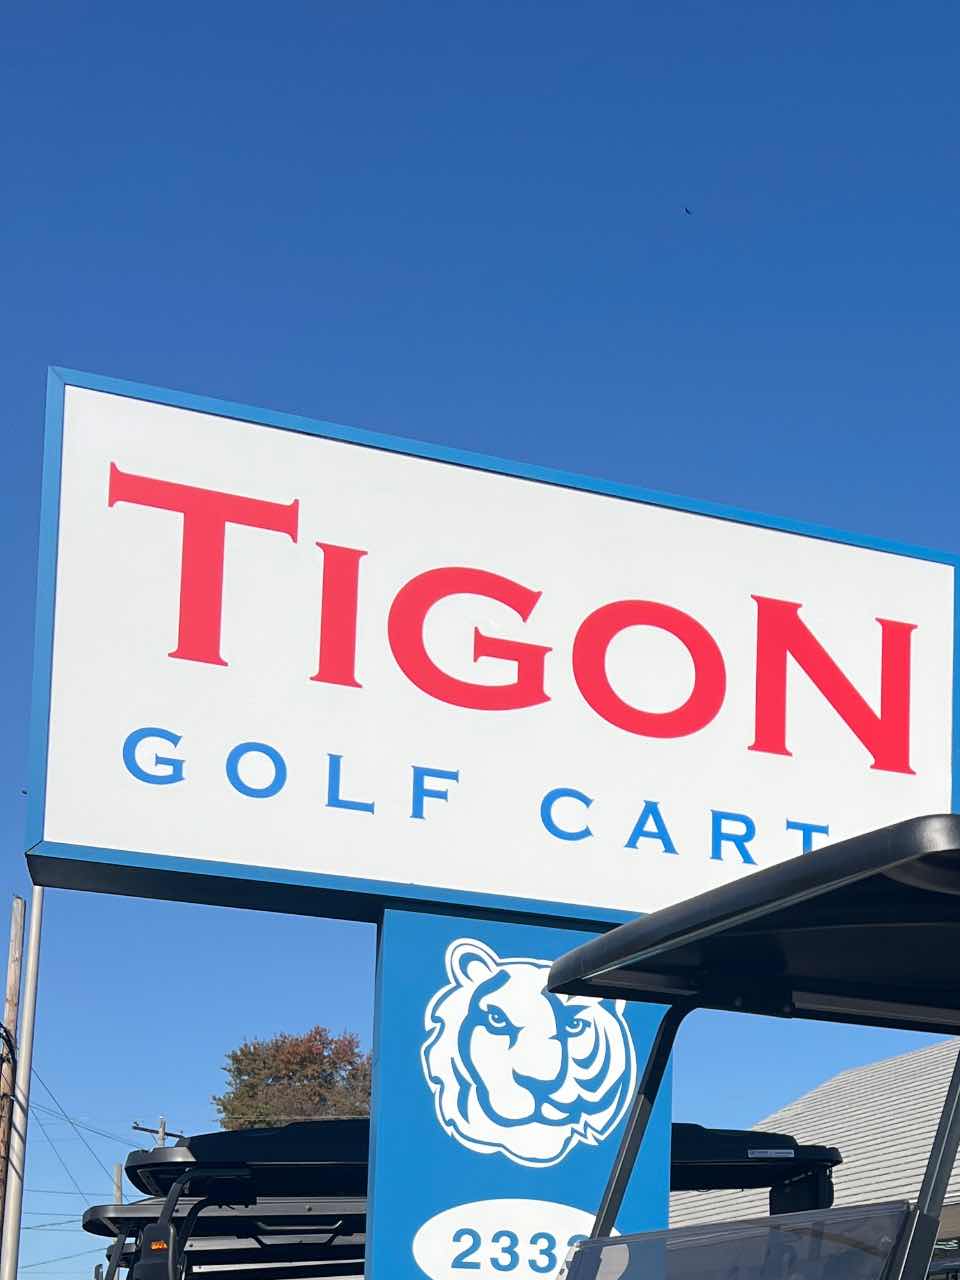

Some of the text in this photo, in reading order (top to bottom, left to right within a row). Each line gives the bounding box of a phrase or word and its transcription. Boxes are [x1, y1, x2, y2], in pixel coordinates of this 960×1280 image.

[107, 461, 917, 776] TIGON
[122, 726, 830, 866] GOLF CART
[450, 1227, 590, 1274] 233
